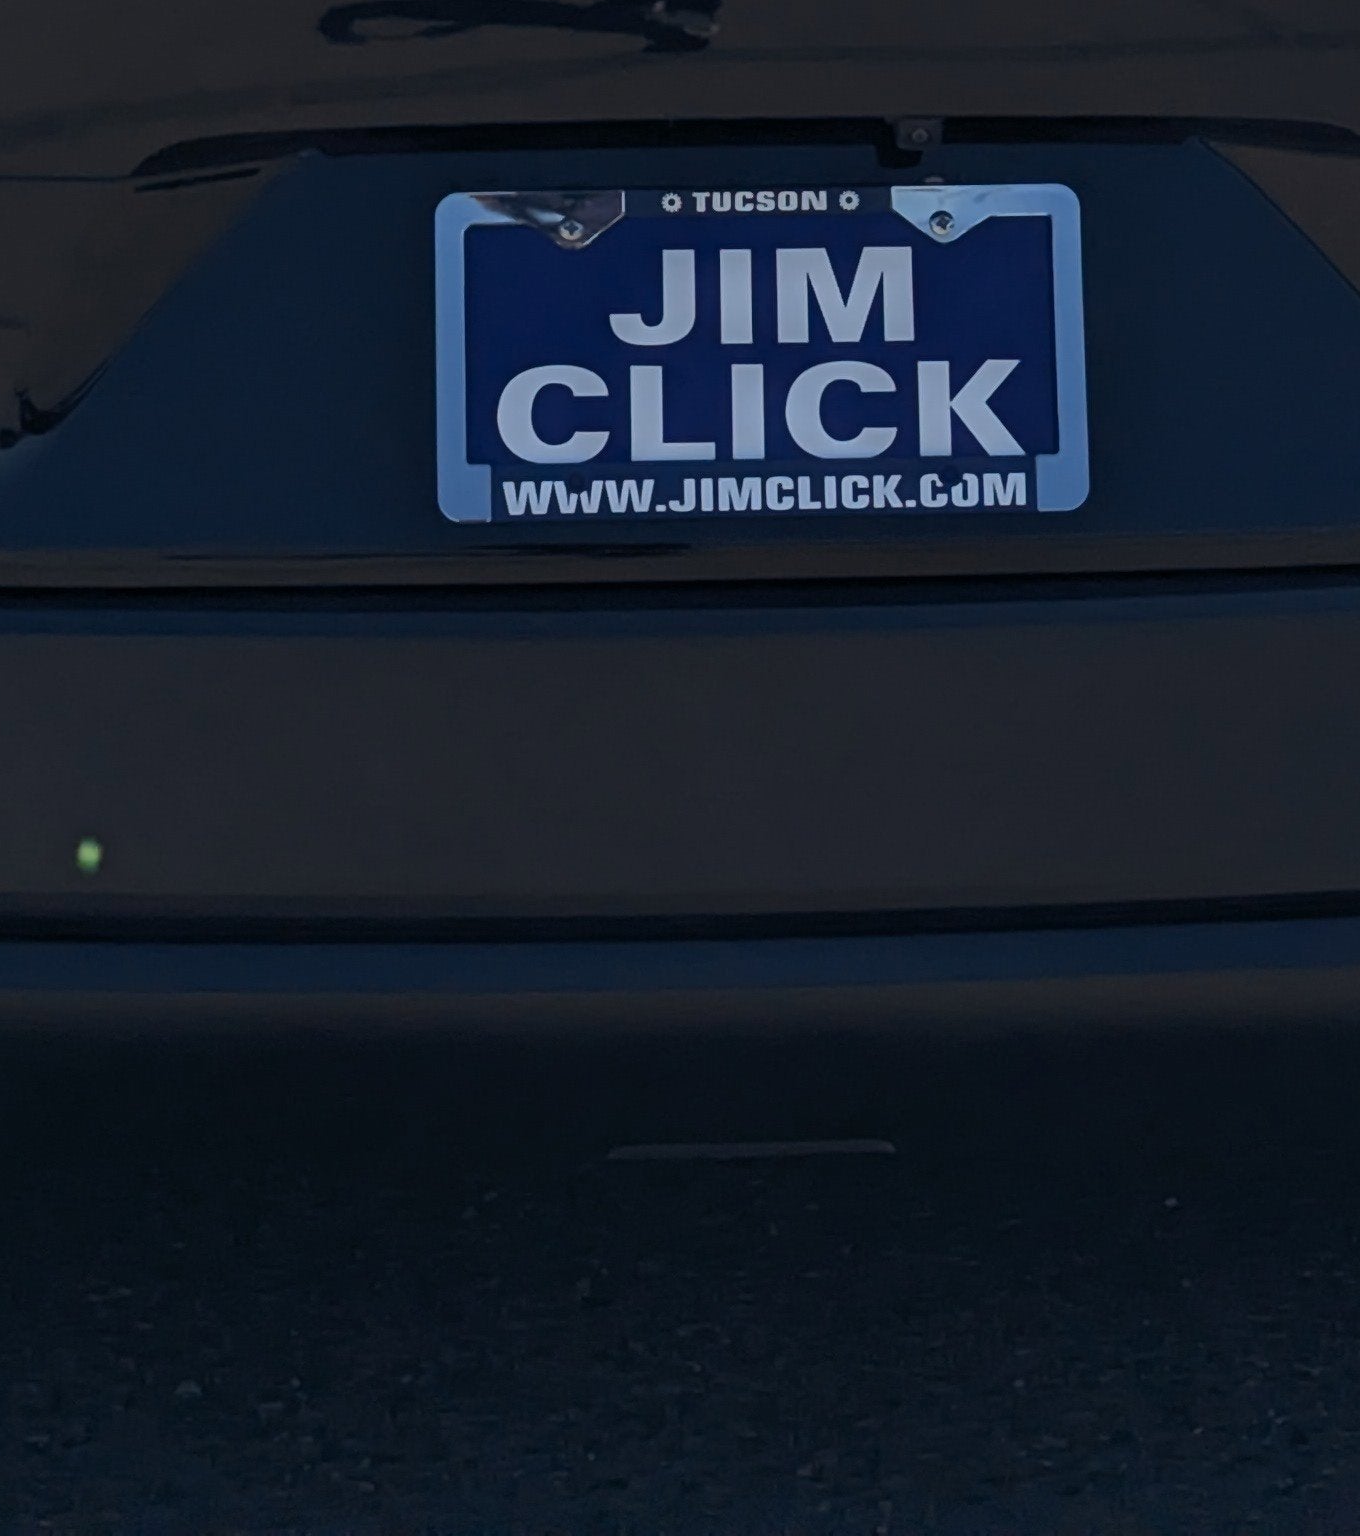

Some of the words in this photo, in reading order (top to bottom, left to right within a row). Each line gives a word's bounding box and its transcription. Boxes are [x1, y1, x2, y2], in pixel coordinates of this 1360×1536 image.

[692, 190, 828, 212] TUCSON
[609, 245, 915, 347] JIM
[496, 358, 1027, 465] CLICK
[502, 472, 1028, 517] WWW.JIMCLICK.COM
